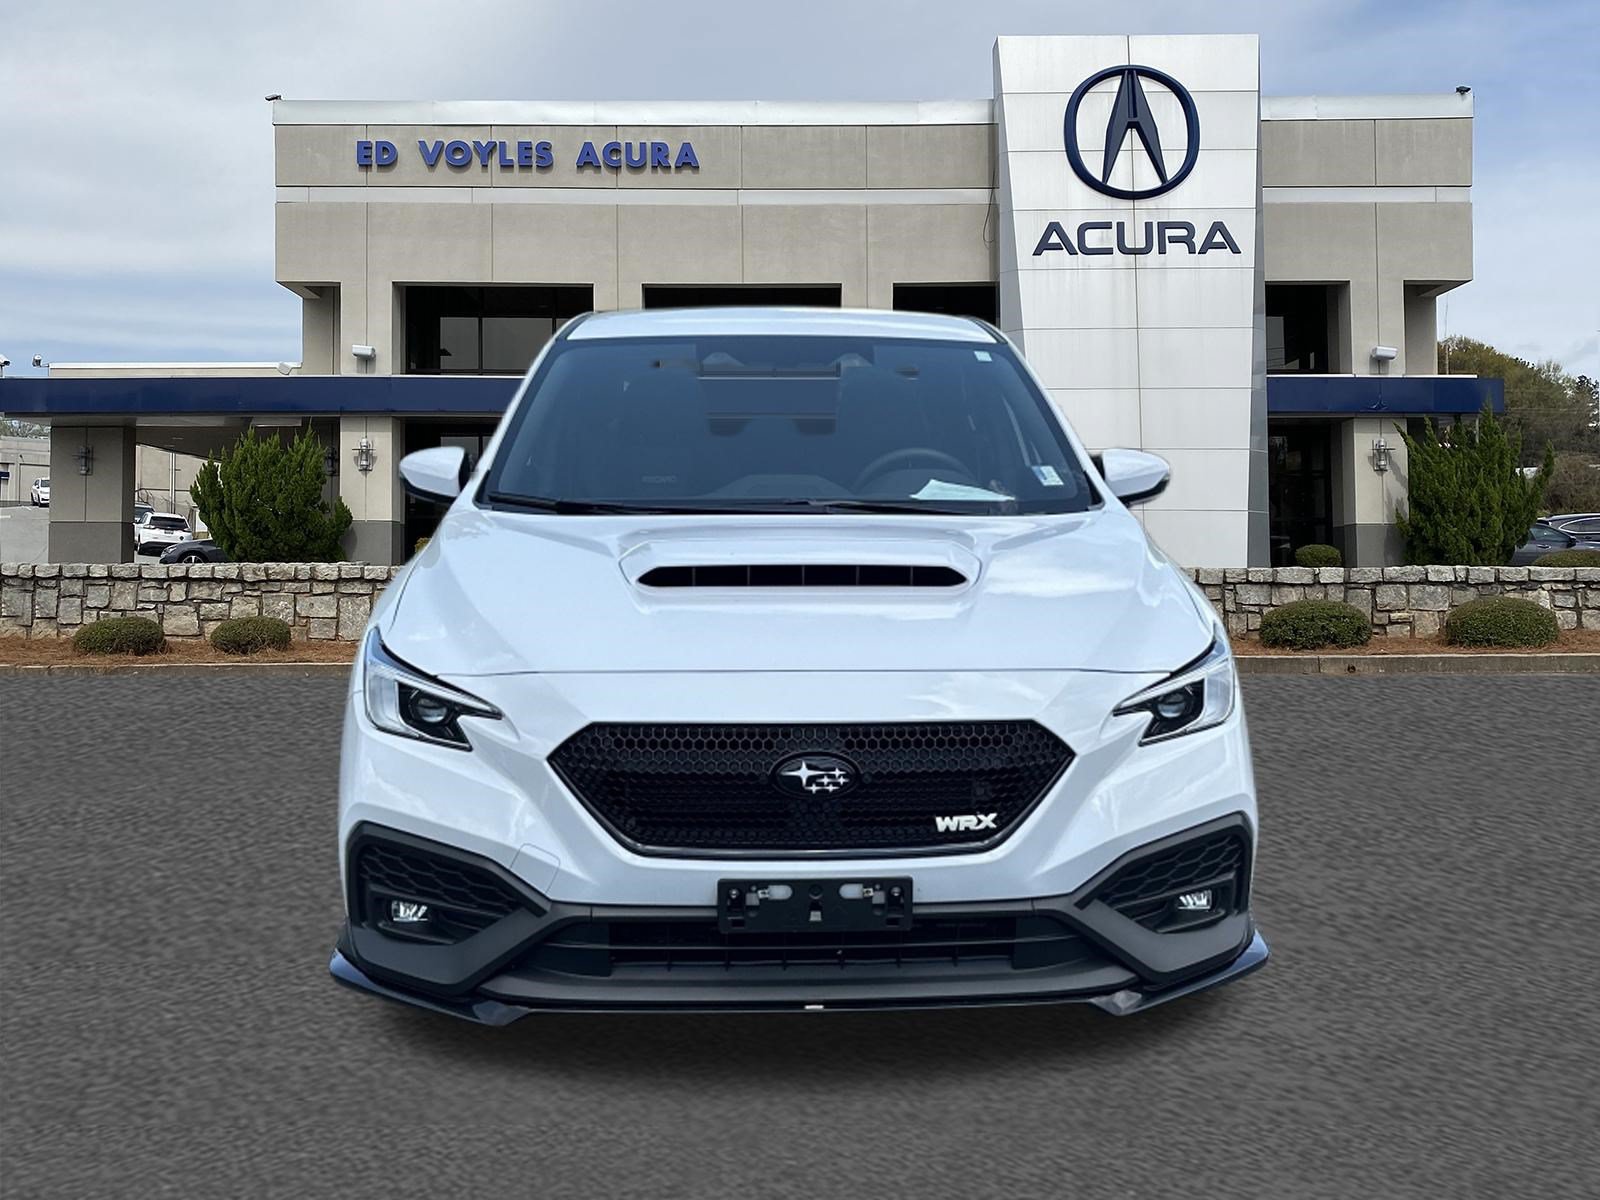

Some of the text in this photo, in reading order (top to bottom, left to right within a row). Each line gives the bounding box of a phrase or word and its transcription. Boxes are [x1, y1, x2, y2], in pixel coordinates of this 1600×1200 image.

[356, 140, 700, 169] ED VOYLES ACURA
[1031, 221, 1242, 256] ACURA
[935, 812, 998, 833] WRX
